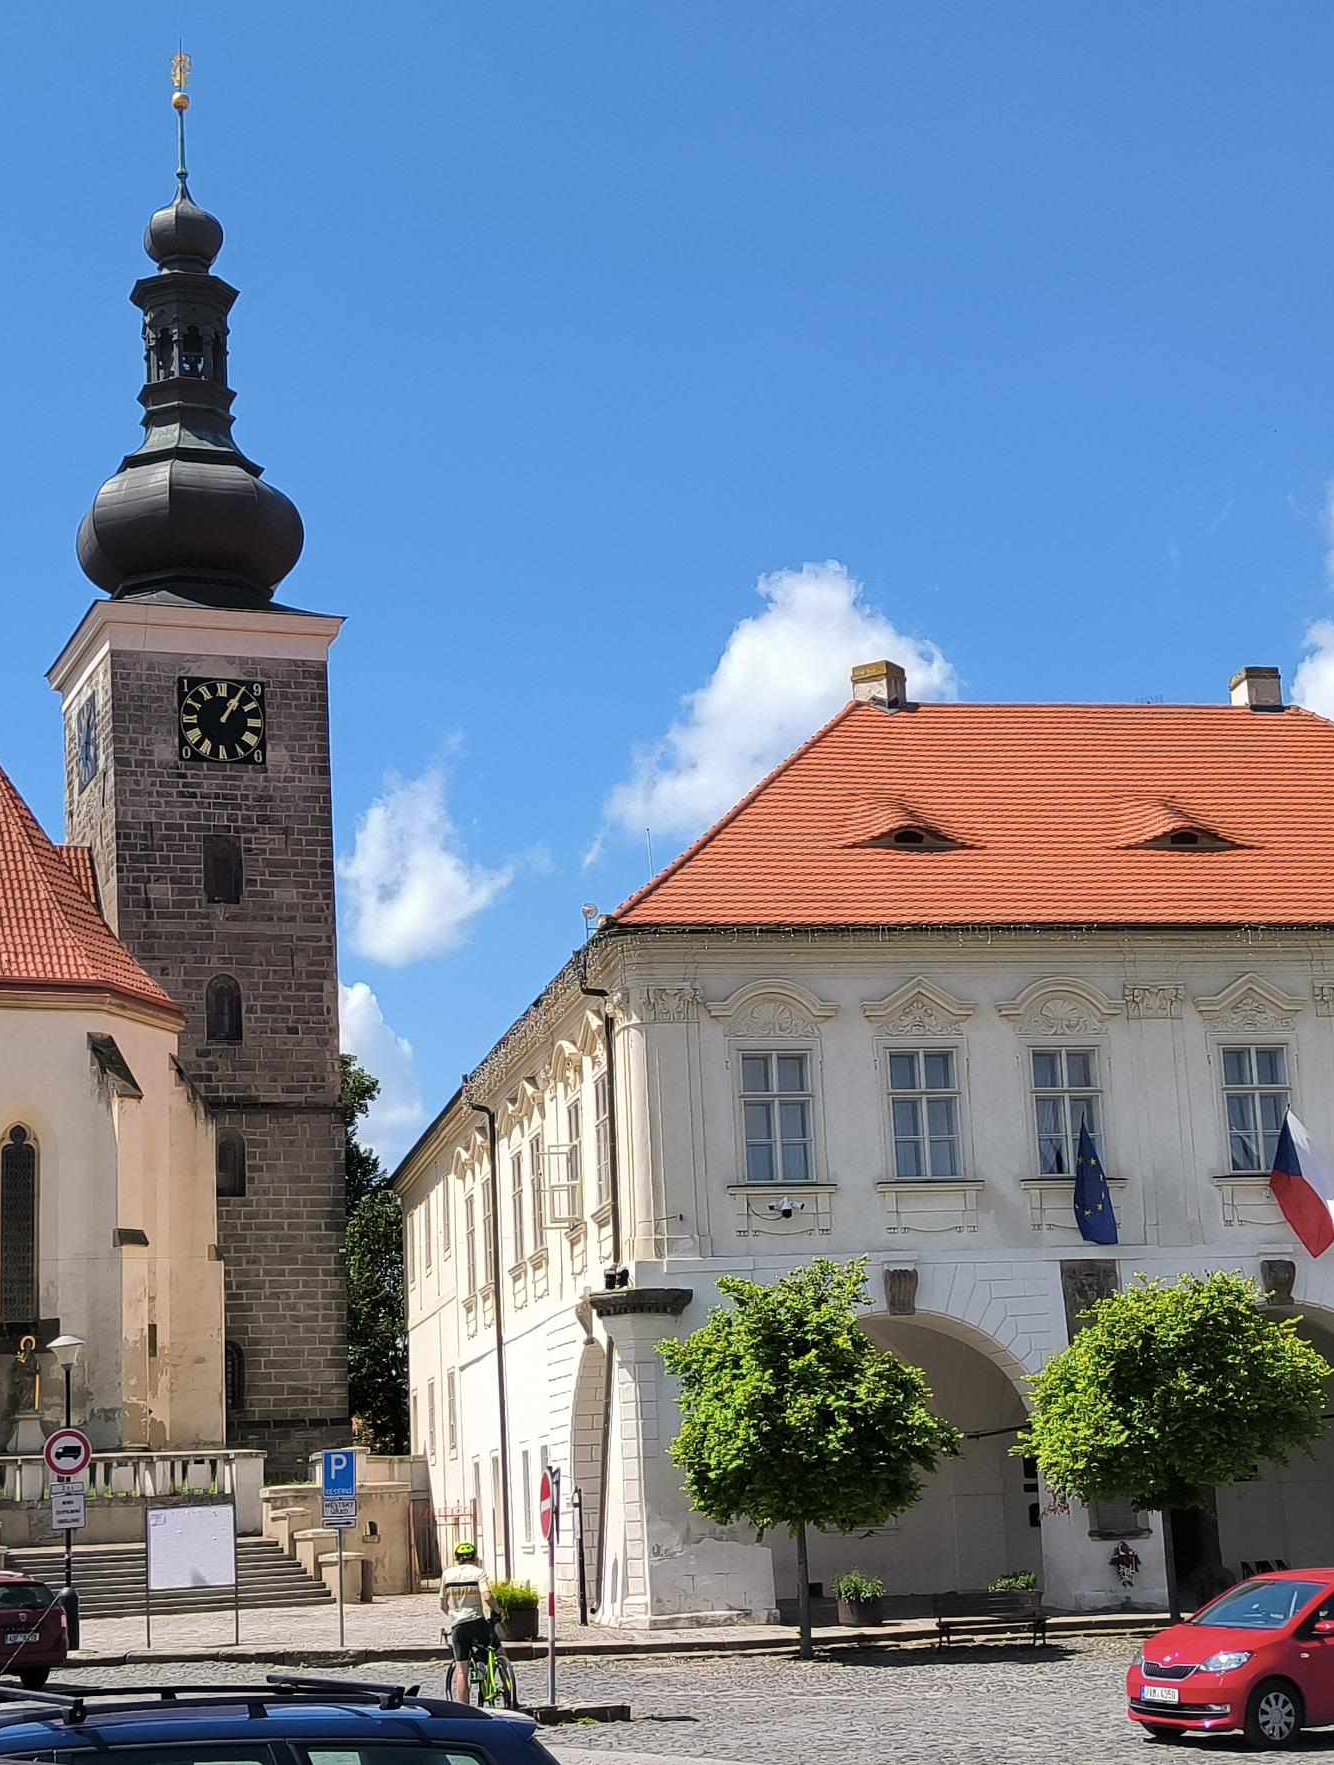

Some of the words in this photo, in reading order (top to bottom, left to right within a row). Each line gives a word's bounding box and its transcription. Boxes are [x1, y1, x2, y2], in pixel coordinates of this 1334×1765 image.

[183, 679, 188, 691] 1
[253, 684, 261, 696] 9
[182, 746, 191, 759] 0
[331, 1454, 347, 1480] P
